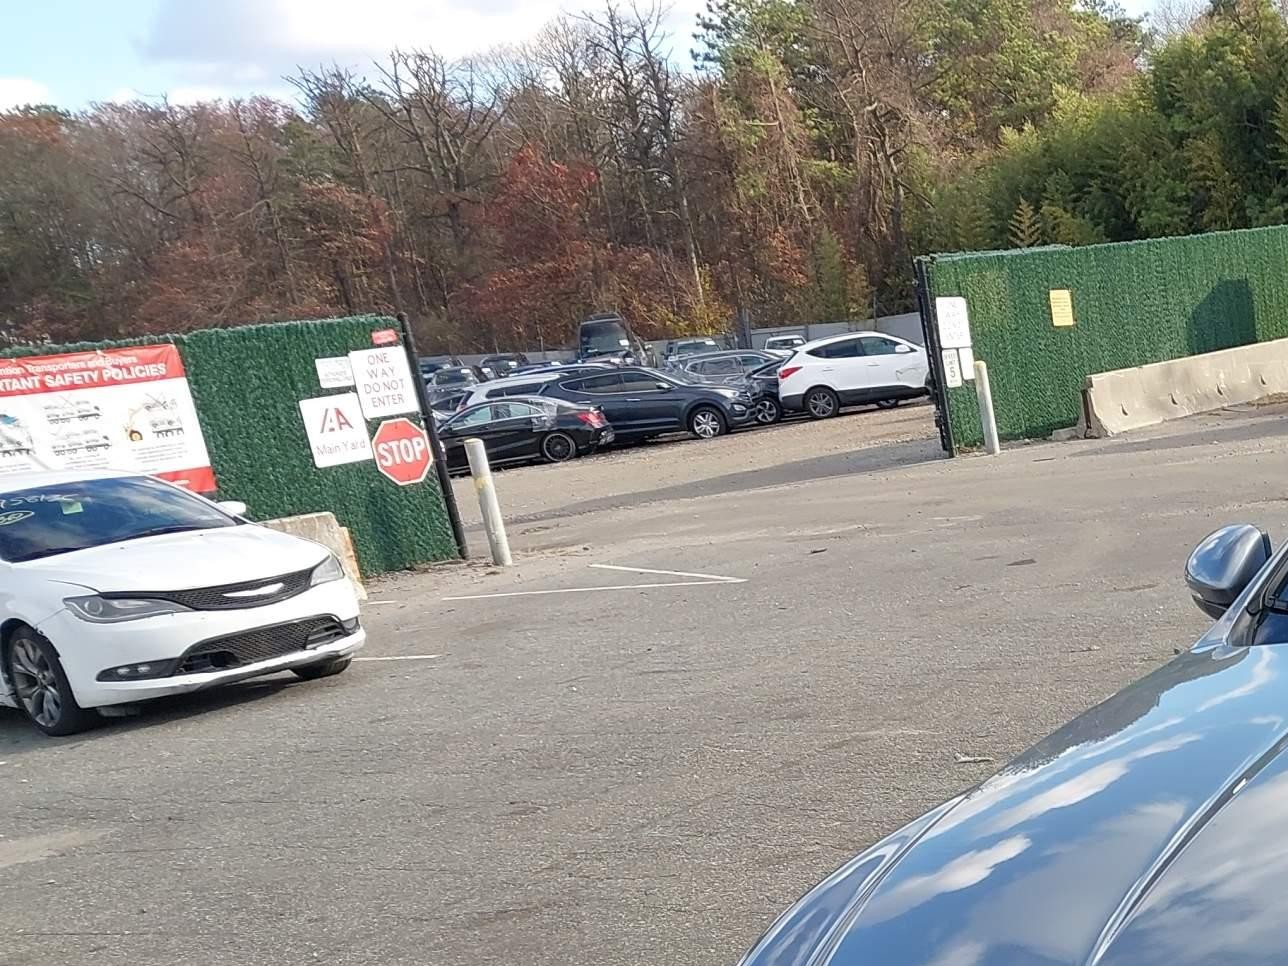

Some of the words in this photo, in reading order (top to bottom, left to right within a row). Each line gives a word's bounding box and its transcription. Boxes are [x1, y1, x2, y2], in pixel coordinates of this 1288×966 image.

[368, 352, 390, 365] ONE
[45, 370, 99, 388] SAFETY
[102, 363, 167, 381] POLICIES
[949, 366, 956, 378] 5
[363, 383, 381, 395] DO
[383, 379, 404, 392] NOT
[371, 394, 405, 408] ENTER
[316, 443, 341, 456] Main
[342, 439, 366, 452] Yard
[377, 437, 425, 467] STOP
